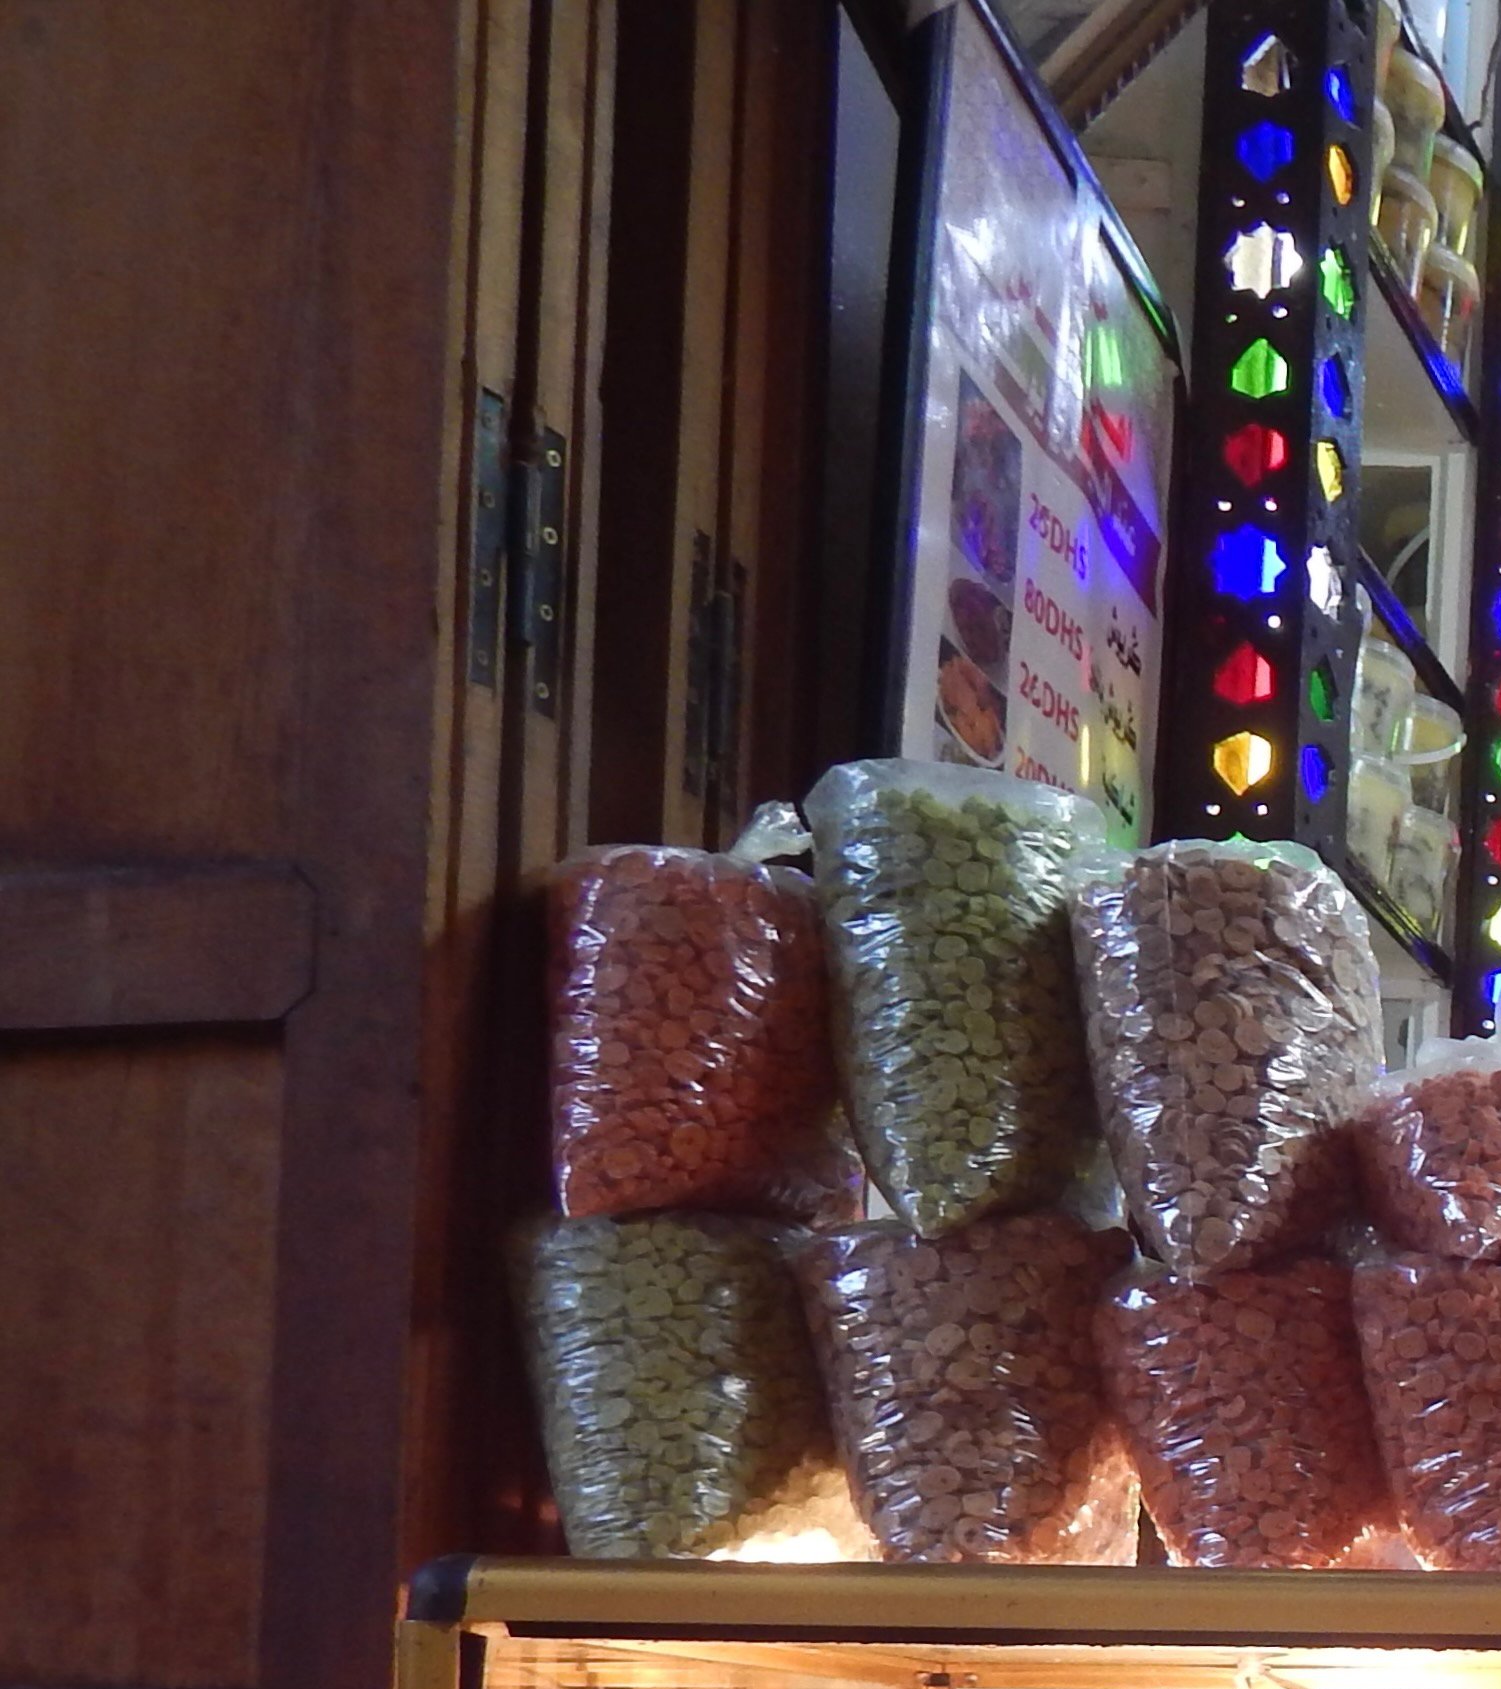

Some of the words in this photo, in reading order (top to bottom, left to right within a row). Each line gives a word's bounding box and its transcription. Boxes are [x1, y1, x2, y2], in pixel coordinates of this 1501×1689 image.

[1028, 492, 1087, 580] 25DHS
[1024, 576, 1083, 662] 80DHS
[1015, 745, 1076, 794] 20D
